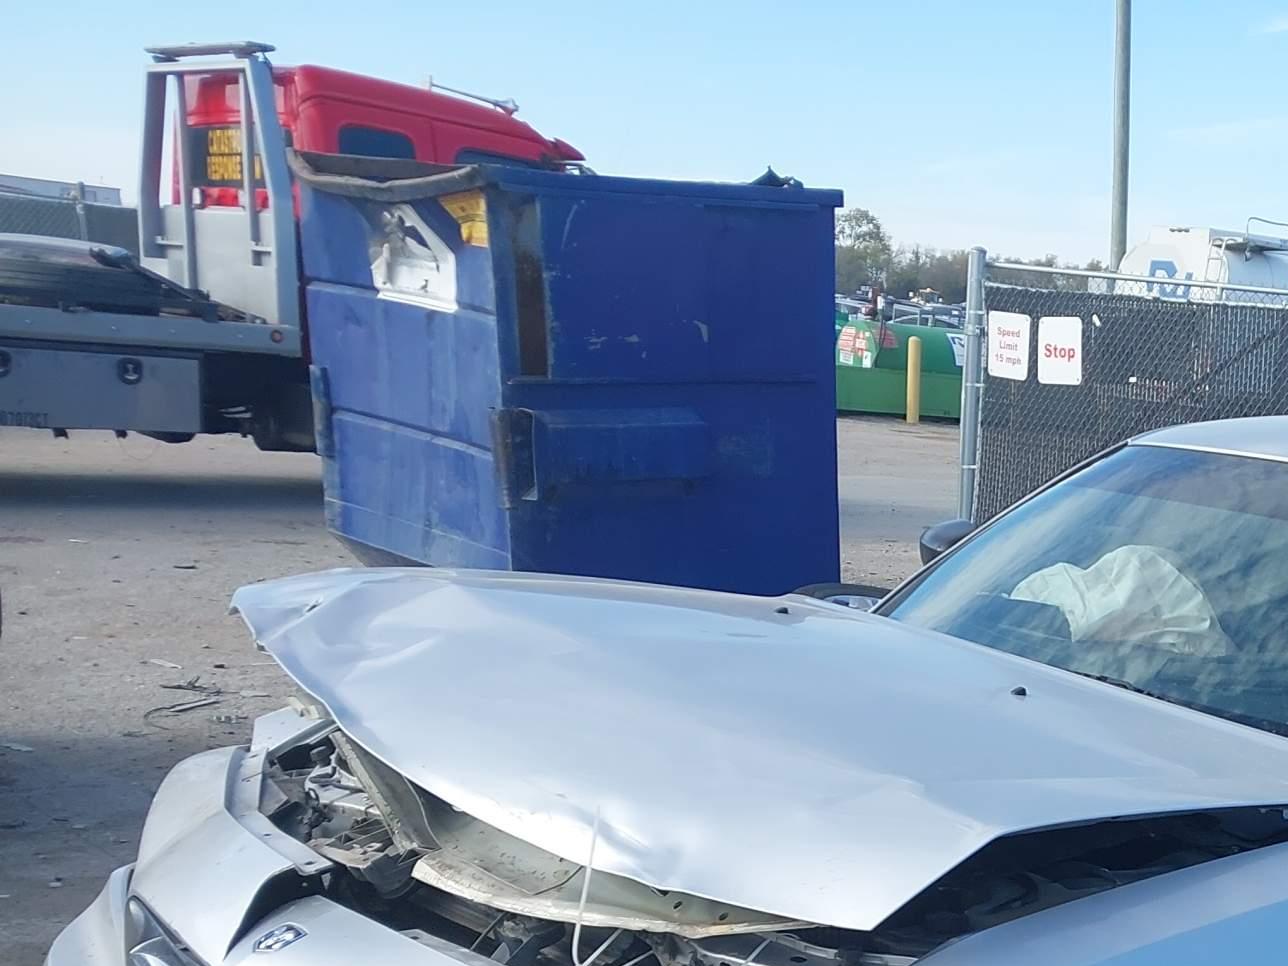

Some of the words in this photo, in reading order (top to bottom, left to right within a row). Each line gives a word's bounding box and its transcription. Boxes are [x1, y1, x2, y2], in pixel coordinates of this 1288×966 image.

[208, 129, 243, 154] CATASTRO
[997, 327, 1021, 338] Speed
[999, 341, 1018, 351] Limit
[995, 353, 1004, 363] 15
[1005, 356, 1022, 366] mph
[1044, 343, 1075, 363] Stop
